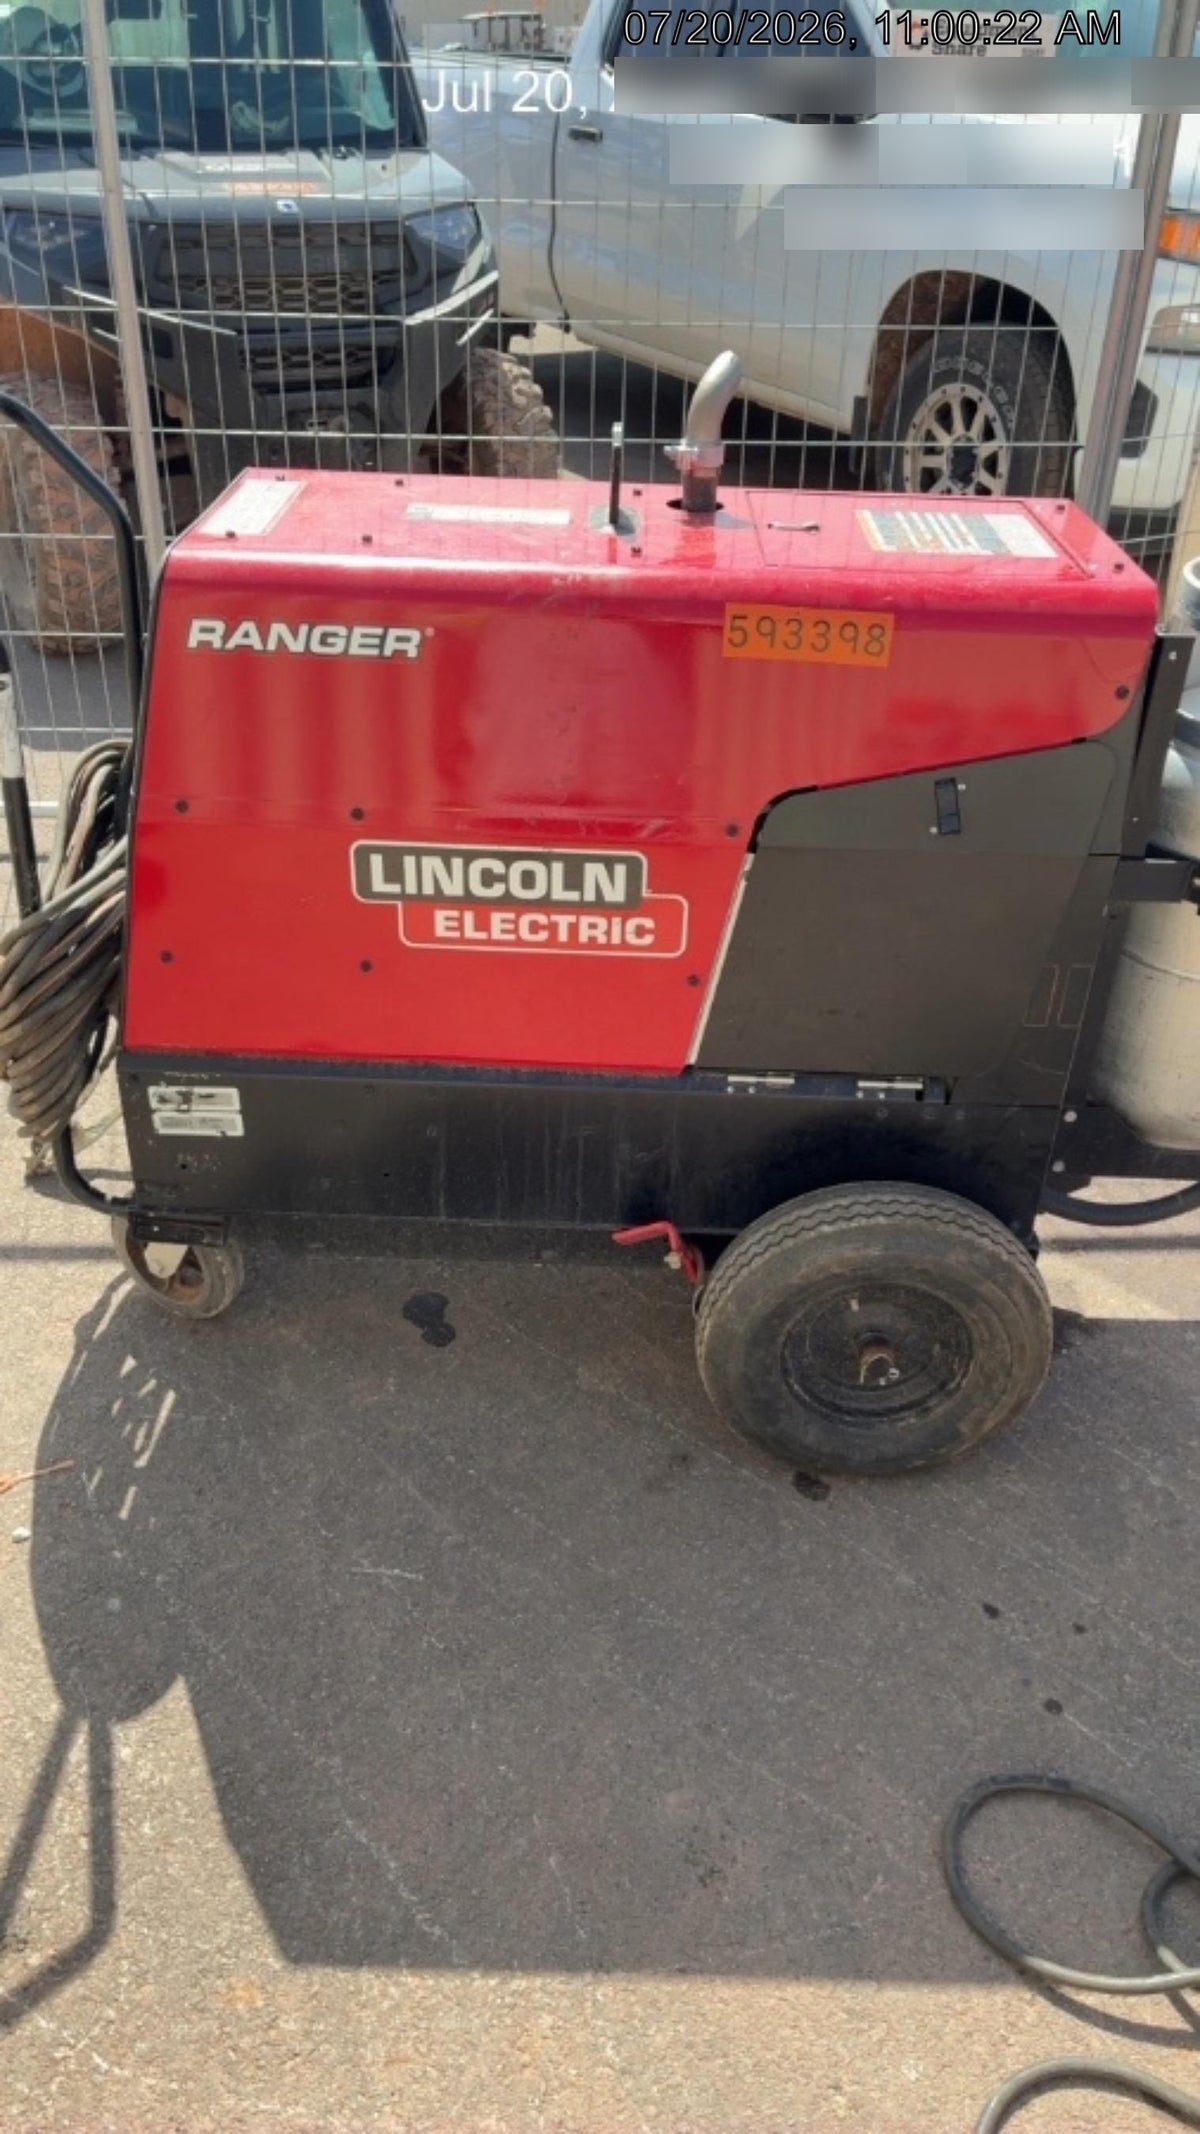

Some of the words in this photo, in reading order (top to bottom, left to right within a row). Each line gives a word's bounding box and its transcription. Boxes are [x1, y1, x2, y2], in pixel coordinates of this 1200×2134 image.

[187, 618, 422, 658] RANGER
[727, 614, 886, 657] 593398
[368, 853, 628, 903] LINCOLN
[433, 909, 656, 946] ELECTRIC
